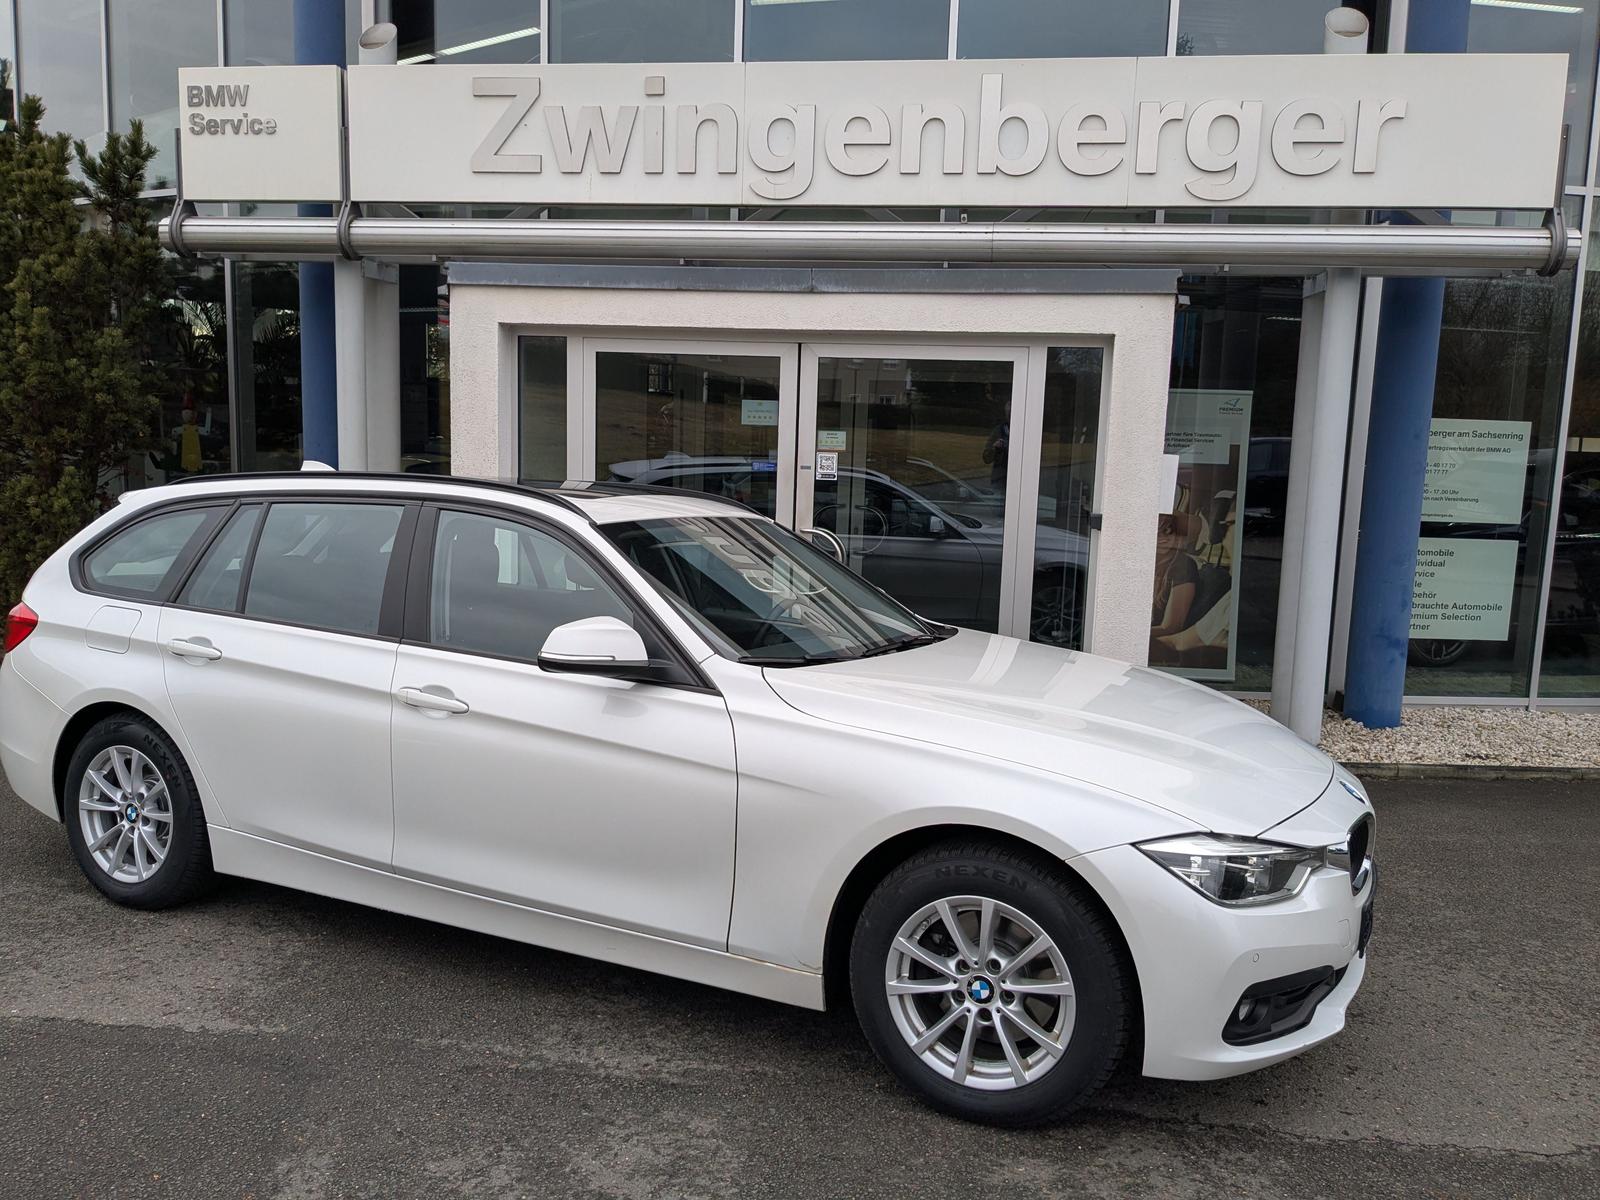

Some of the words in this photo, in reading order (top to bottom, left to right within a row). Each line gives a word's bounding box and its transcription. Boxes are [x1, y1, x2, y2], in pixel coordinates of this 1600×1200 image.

[187, 84, 249, 107] BMW
[188, 112, 277, 135] Service
[470, 73, 1407, 202] Zwingenberger
[1471, 430, 1524, 441] Sachsenring
[1417, 549, 1454, 557] tomobile
[1412, 591, 1437, 599] behör
[1411, 602, 1449, 610] brauchte
[1451, 602, 1503, 611] Automobile
[1440, 612, 1482, 621] Selection
[143, 734, 181, 788] NEXEN
[934, 864, 1028, 892] NEXEN
